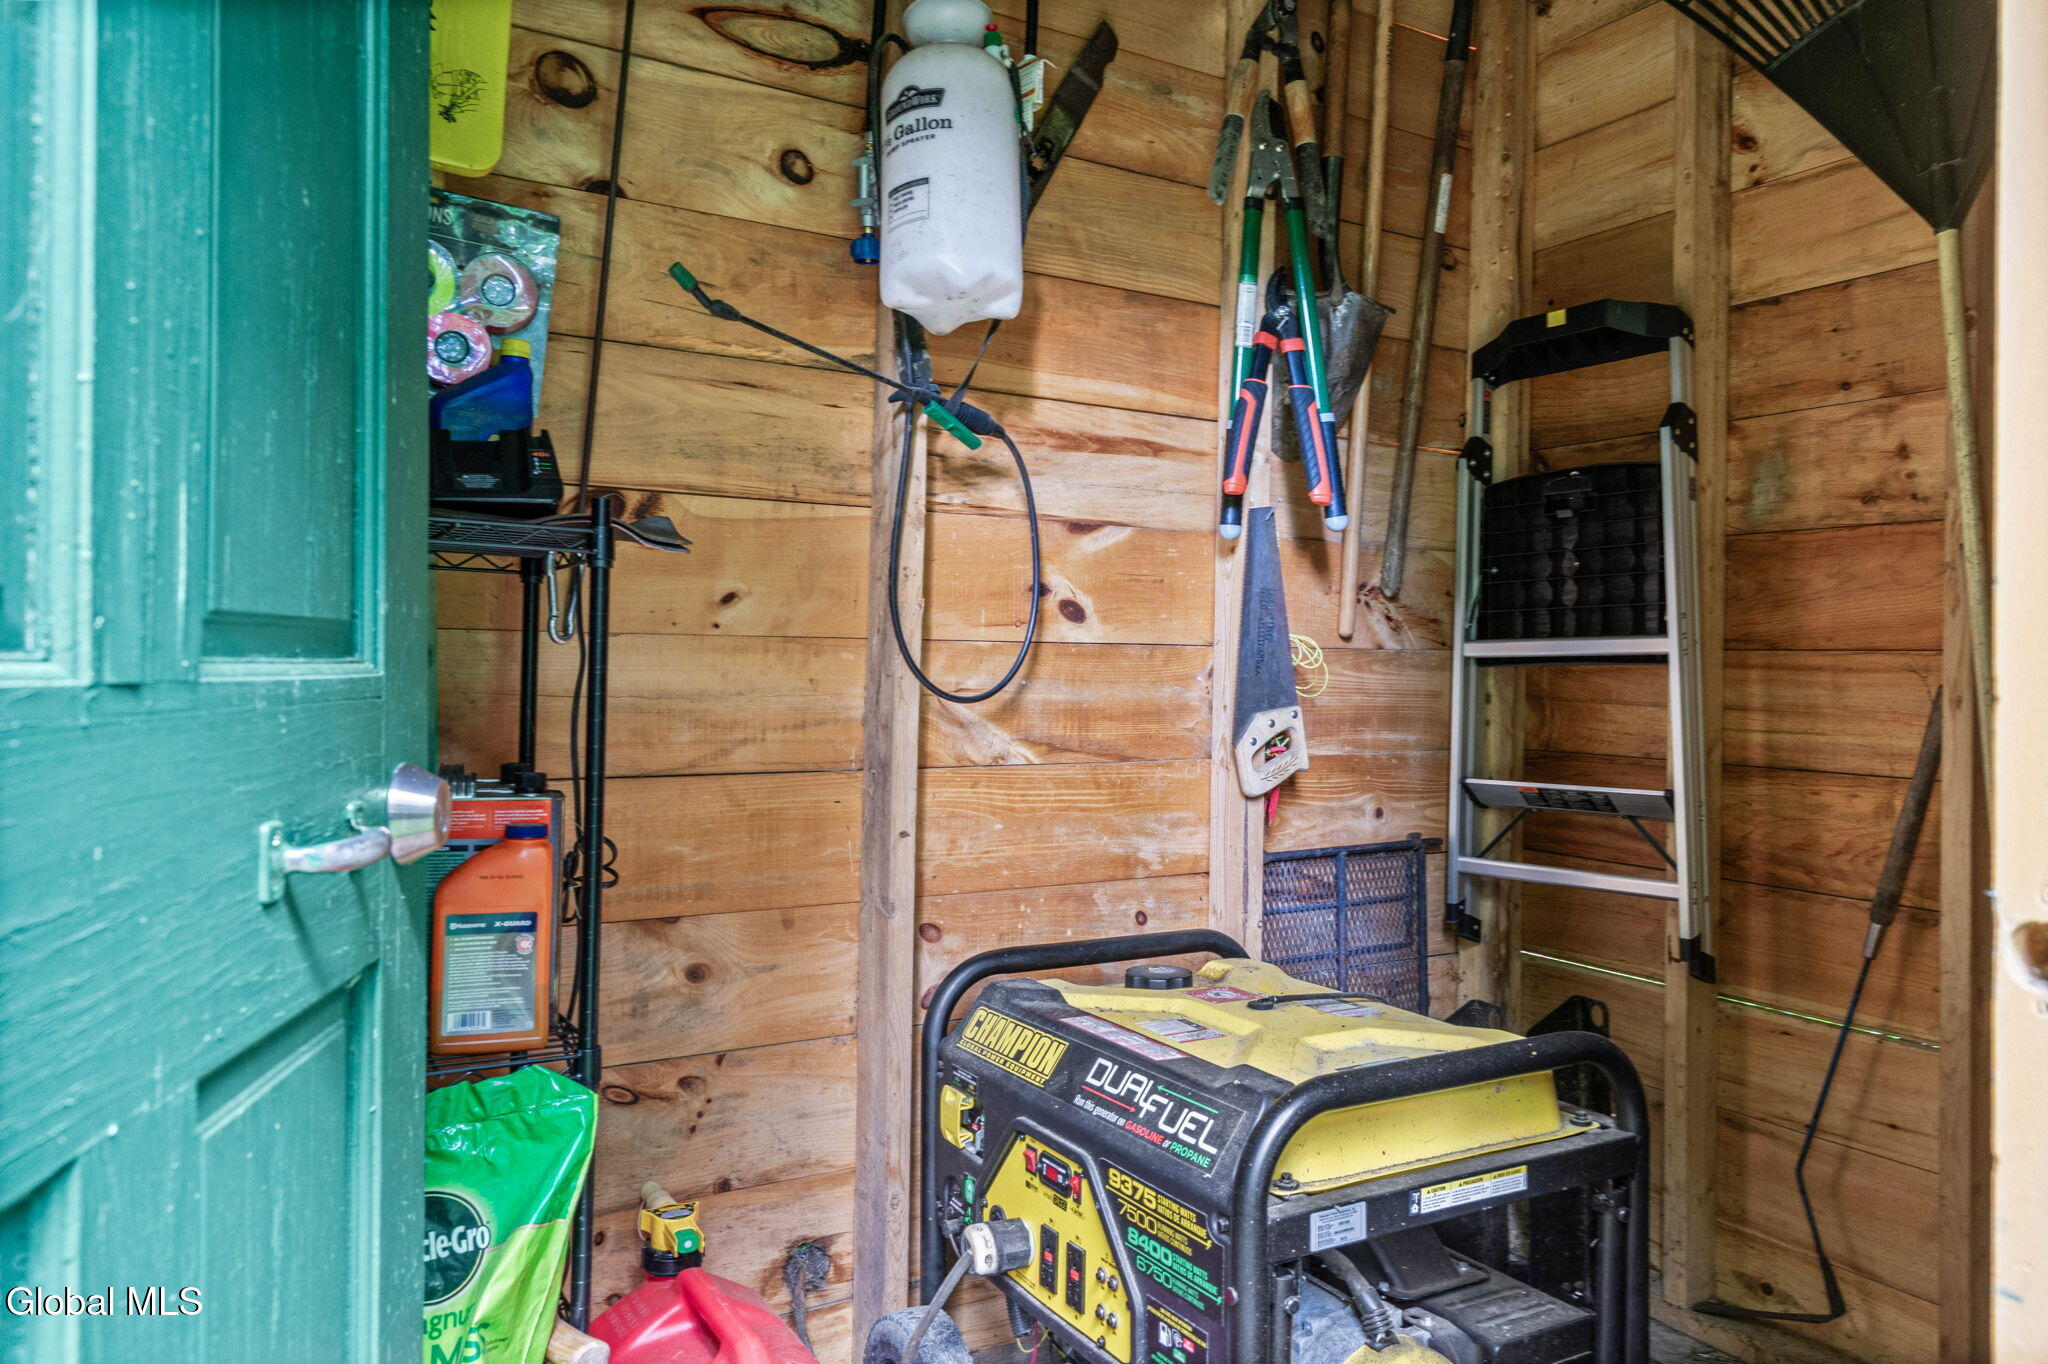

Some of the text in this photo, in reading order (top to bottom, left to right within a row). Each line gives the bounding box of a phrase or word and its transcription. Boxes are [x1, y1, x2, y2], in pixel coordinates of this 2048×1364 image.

[893, 116, 954, 140] Gallon
[901, 133, 937, 148] SPRAYER
[494, 920, 532, 928] X-GUARD
[960, 1040, 1046, 1084] GLOBAL POWER EQUIPMENT
[963, 1008, 1067, 1077] CHAMPION
[1073, 1094, 1212, 1168] Run this generator on GASOLINE or PROPANE
[1138, 1094, 1218, 1155] FUEL
[1108, 1168, 1157, 1210] 9375
[1117, 1198, 1157, 1235] 7500
[1127, 1226, 1173, 1267] 8400
[1136, 1255, 1173, 1288] 6750
